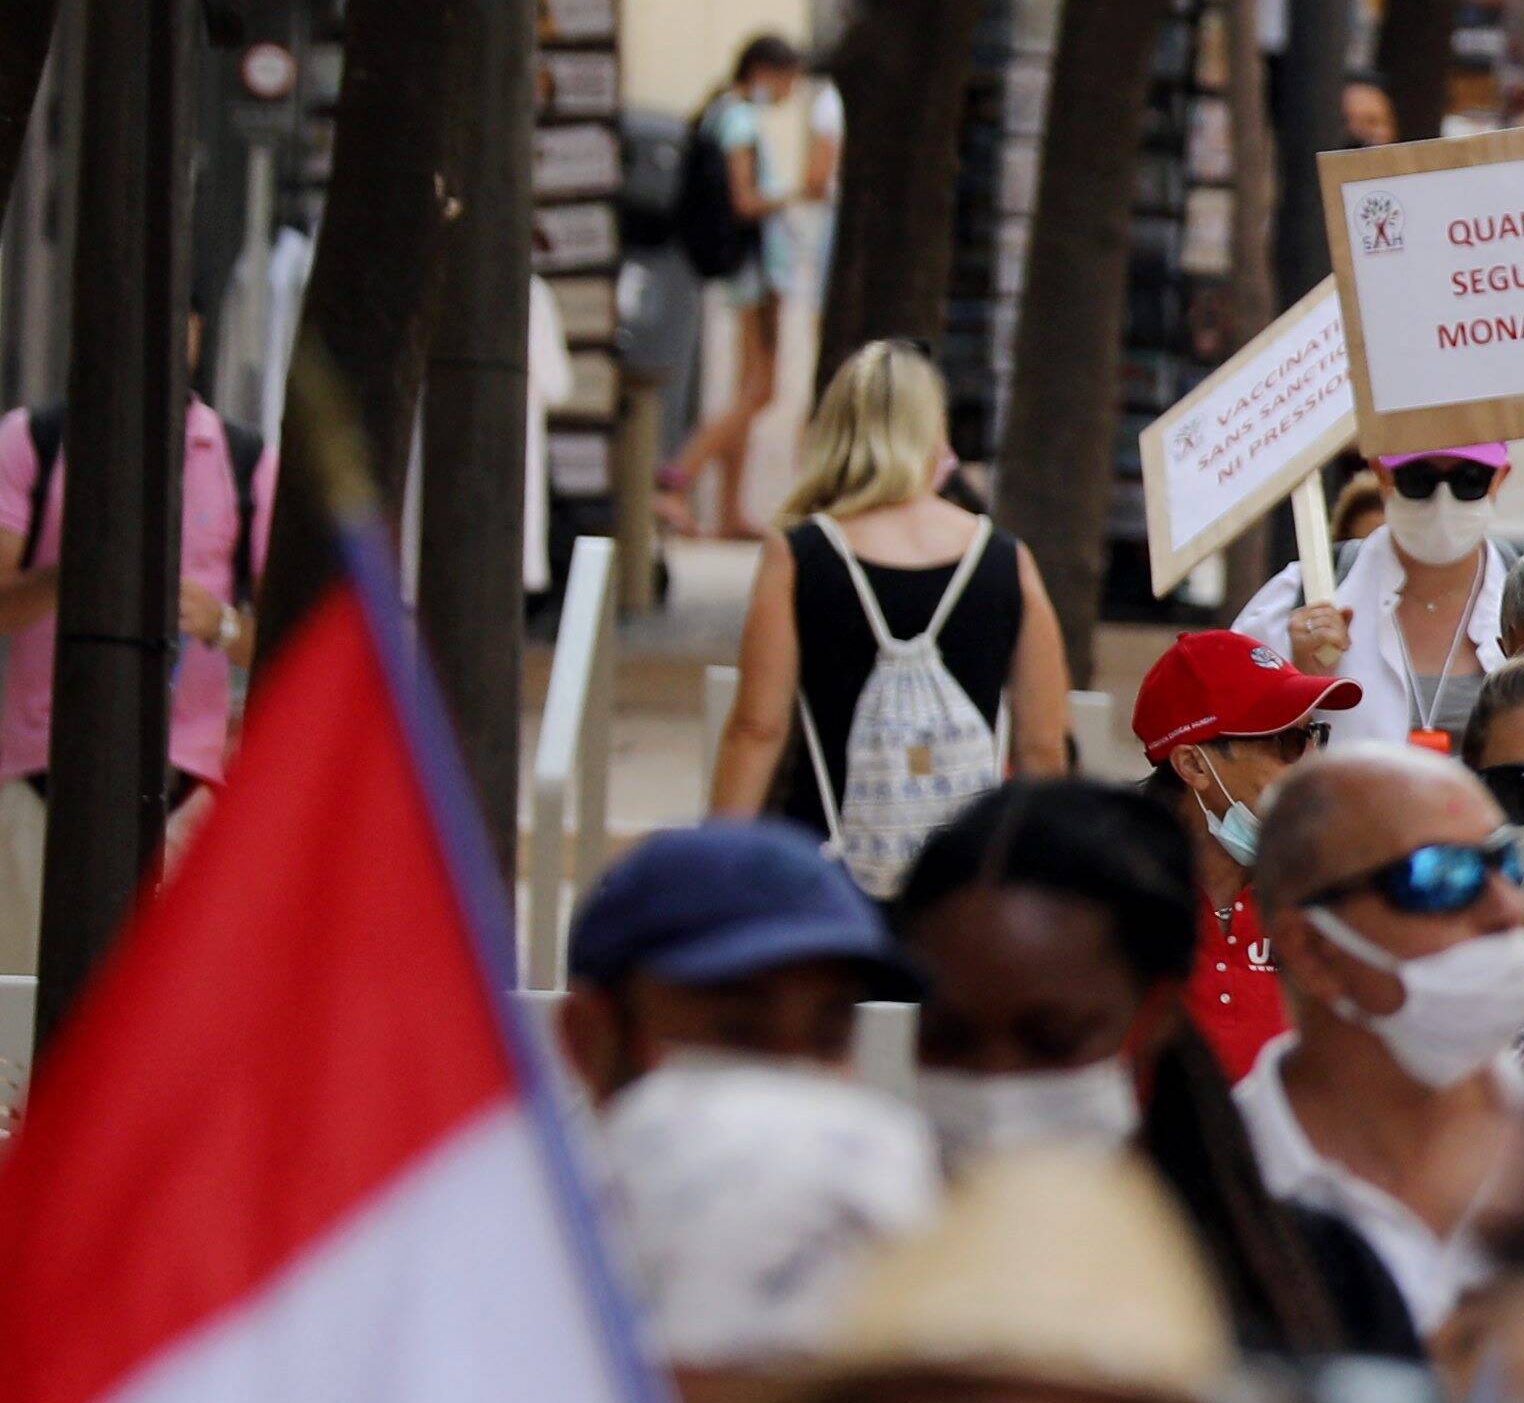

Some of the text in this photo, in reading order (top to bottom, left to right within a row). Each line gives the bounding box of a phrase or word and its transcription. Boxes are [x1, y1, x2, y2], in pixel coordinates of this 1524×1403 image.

[1216, 319, 1340, 428] VACCINATI
[1217, 459, 1243, 485] NI
[1249, 369, 1352, 460] PRESSIO
[1197, 420, 1254, 472] SANS
